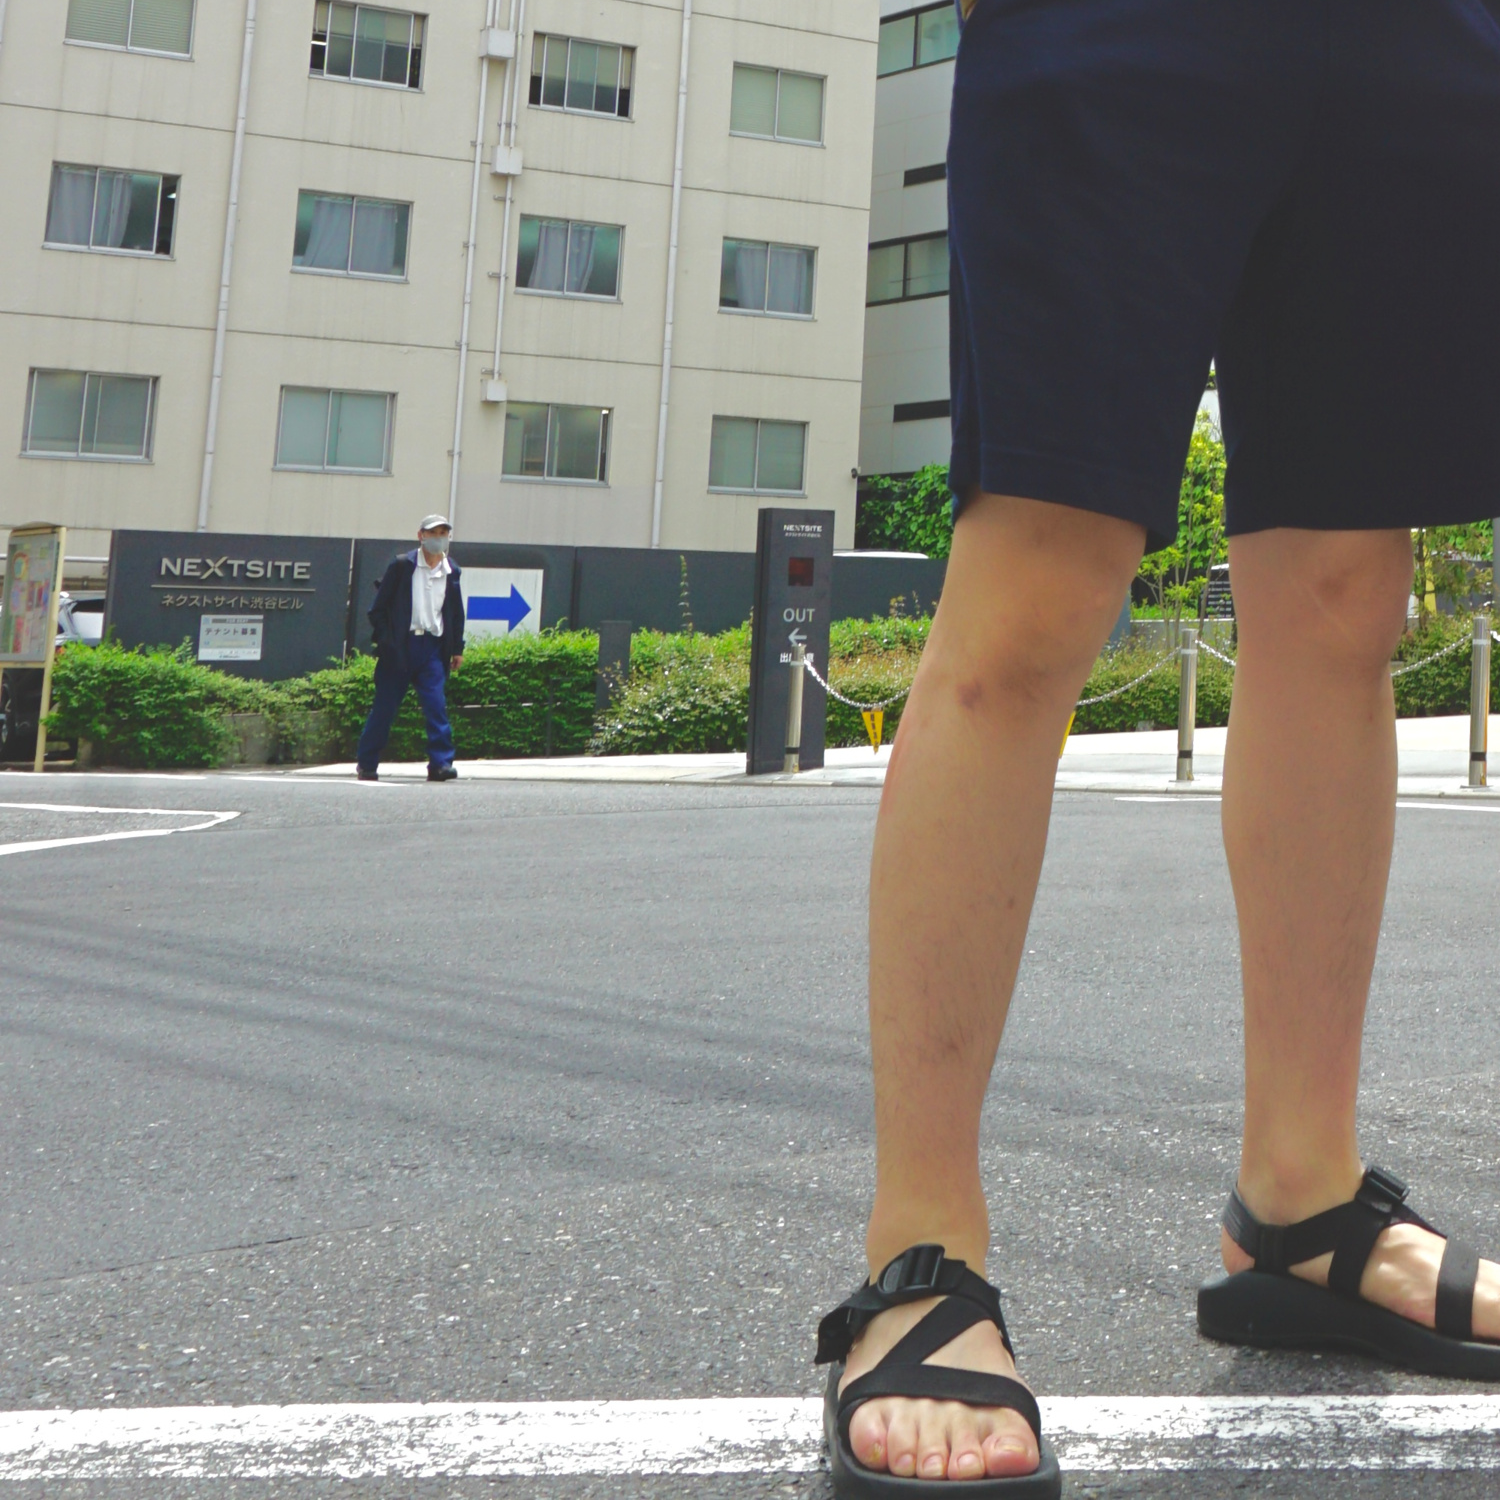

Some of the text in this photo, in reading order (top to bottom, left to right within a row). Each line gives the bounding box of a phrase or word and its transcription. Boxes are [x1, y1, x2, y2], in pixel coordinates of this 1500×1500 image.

[160, 556, 311, 580] NEXTSITE
[161, 594, 304, 610] ネクストサイト渋谷ビル
[783, 607, 816, 623] OUT
